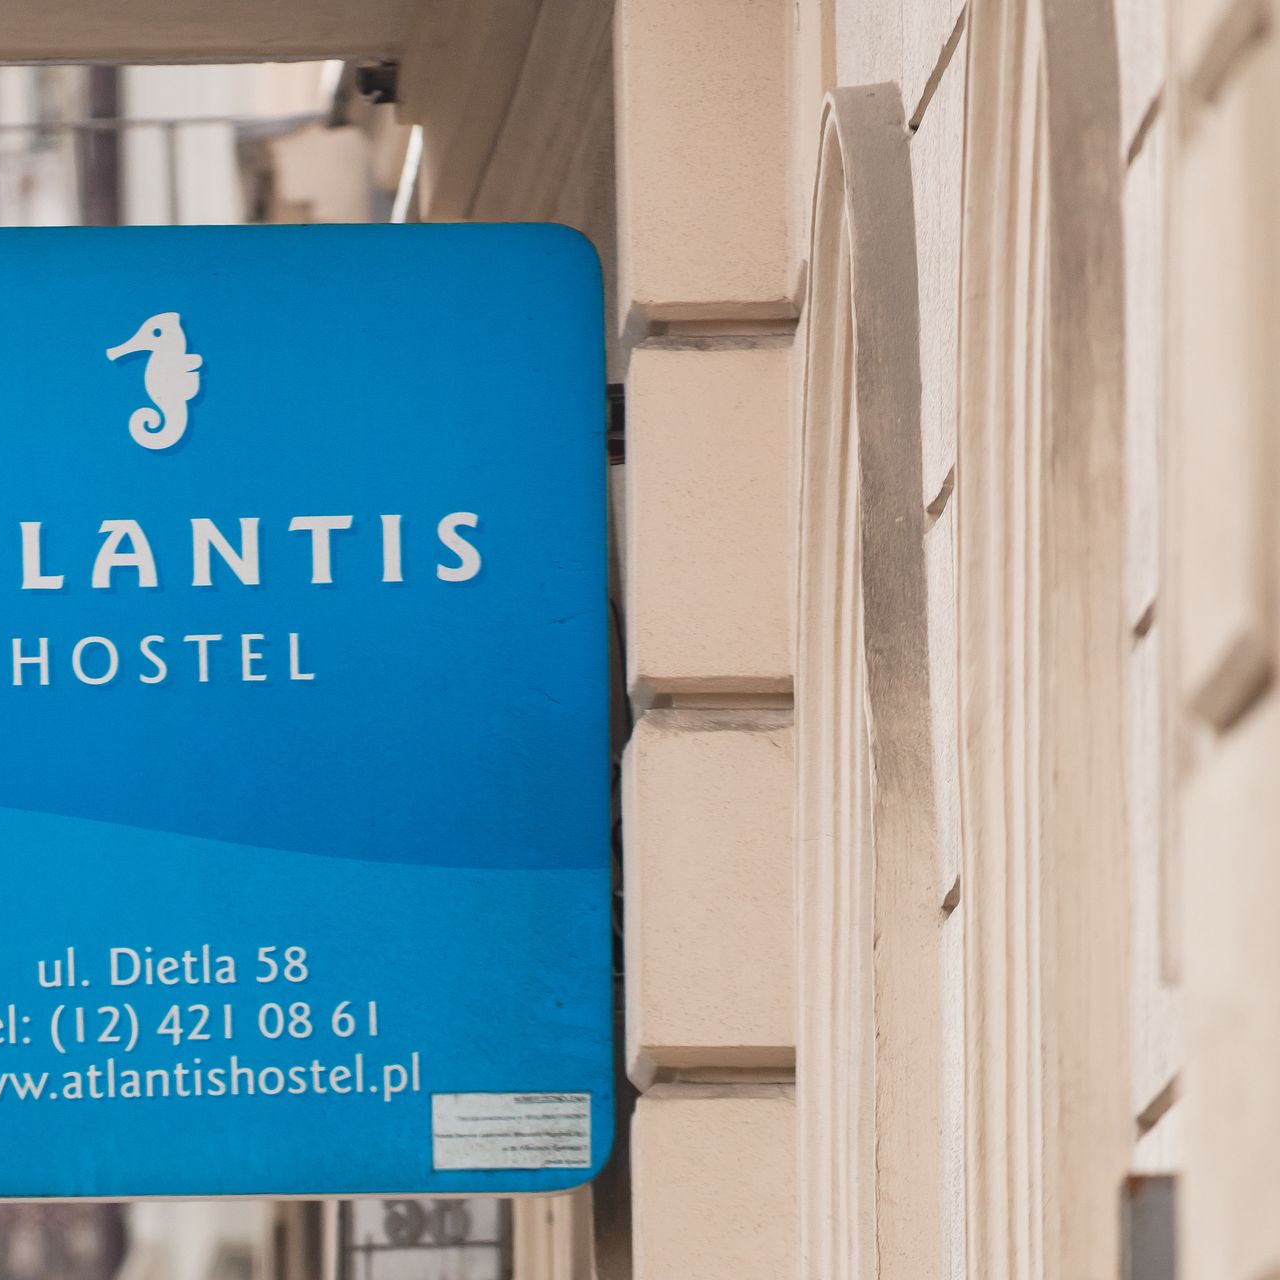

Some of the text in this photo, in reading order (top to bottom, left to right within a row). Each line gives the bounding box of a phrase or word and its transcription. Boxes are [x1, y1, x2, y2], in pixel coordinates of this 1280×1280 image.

[12, 632, 315, 686] HOSTEL
[38, 944, 308, 988] ul. Dietla 58
[51, 1004, 140, 1053] (12)
[157, 1004, 232, 1046] 421
[258, 1001, 313, 1039] 08
[332, 1000, 377, 1038] 61
